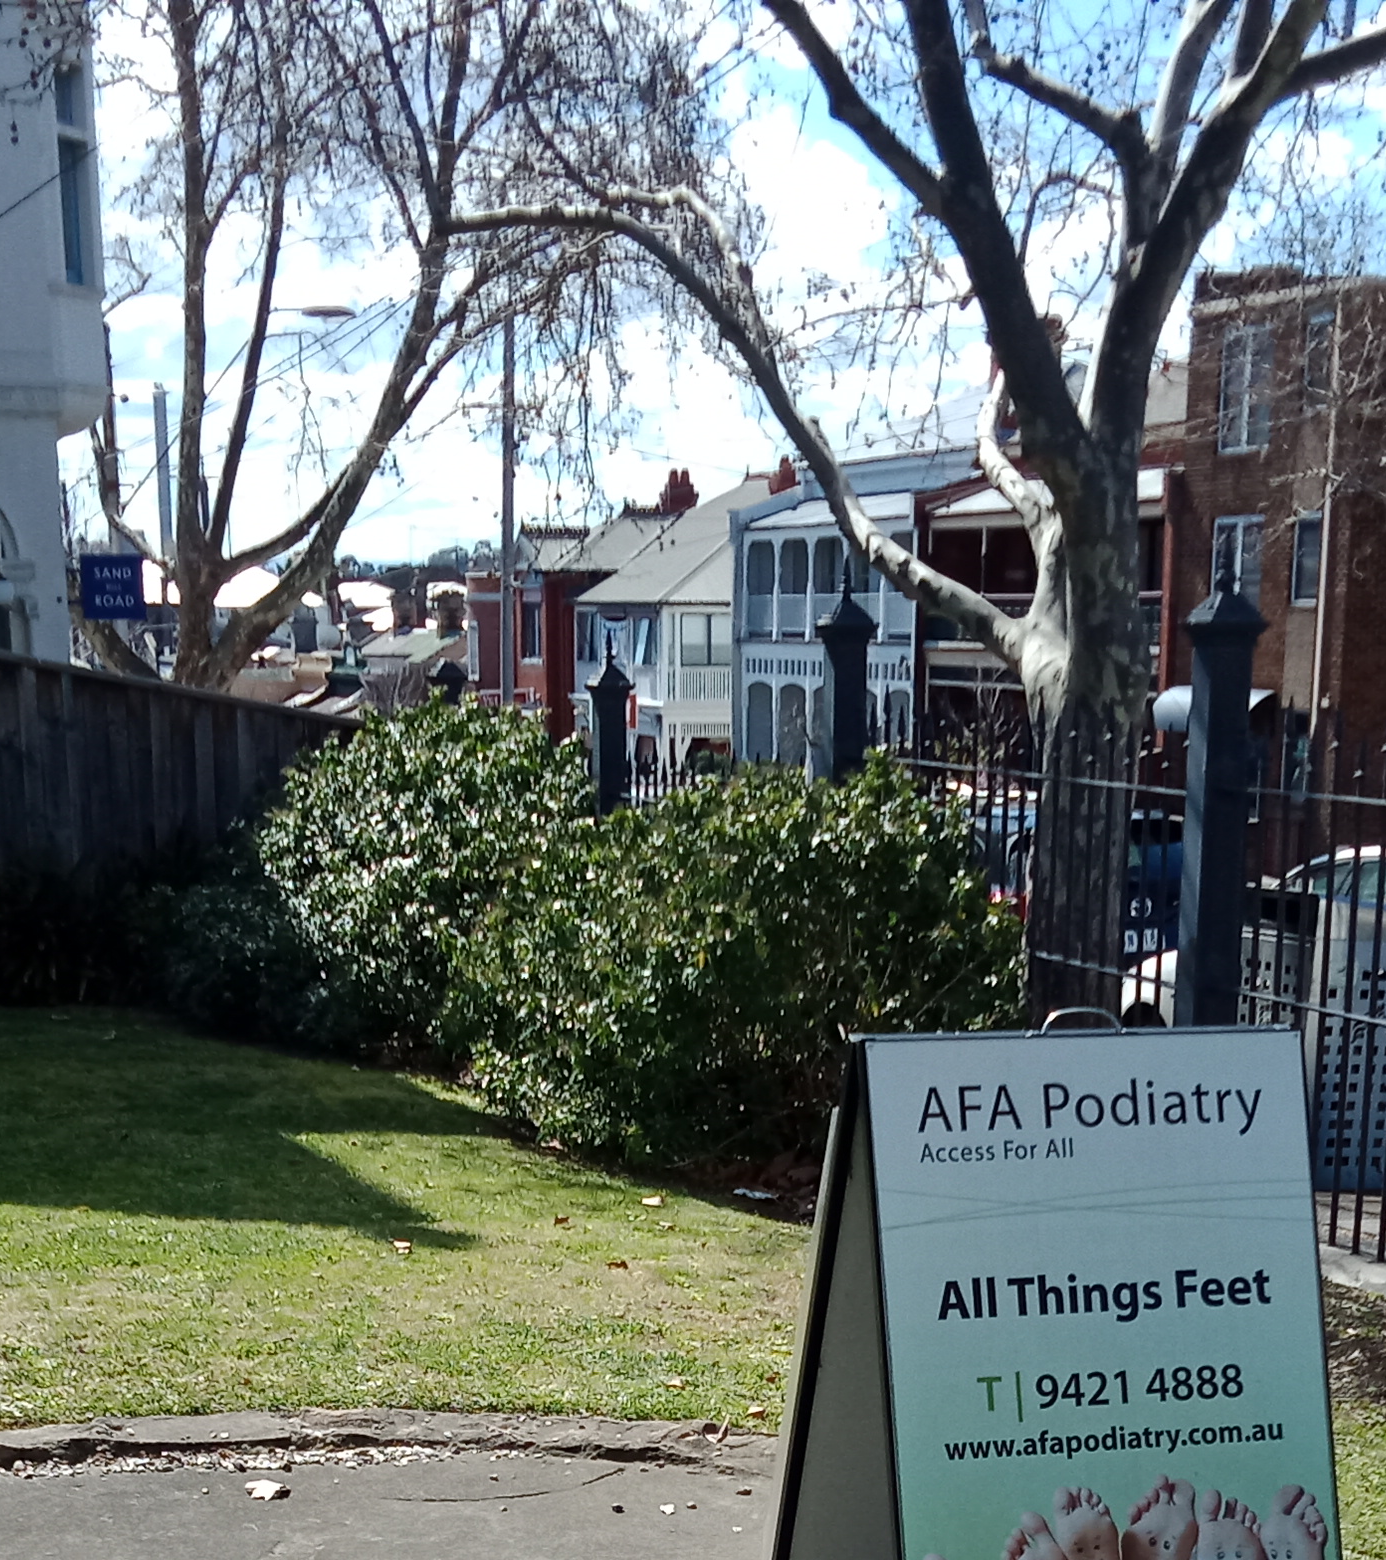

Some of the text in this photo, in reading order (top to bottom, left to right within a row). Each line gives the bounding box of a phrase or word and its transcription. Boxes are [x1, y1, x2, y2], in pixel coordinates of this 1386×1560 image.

[93, 566, 132, 579] SAND
[94, 594, 135, 608] ROAD
[918, 1078, 1262, 1136] AFA Podiatry
[919, 1137, 1075, 1164] Access For All
[937, 1268, 1272, 1323] All Things Feet
[976, 1376, 1002, 1412] T
[1035, 1370, 1130, 1410] 9421
[1145, 1363, 1244, 1403] 4888
[944, 1420, 1284, 1461] www.afapodiatry.com.au
